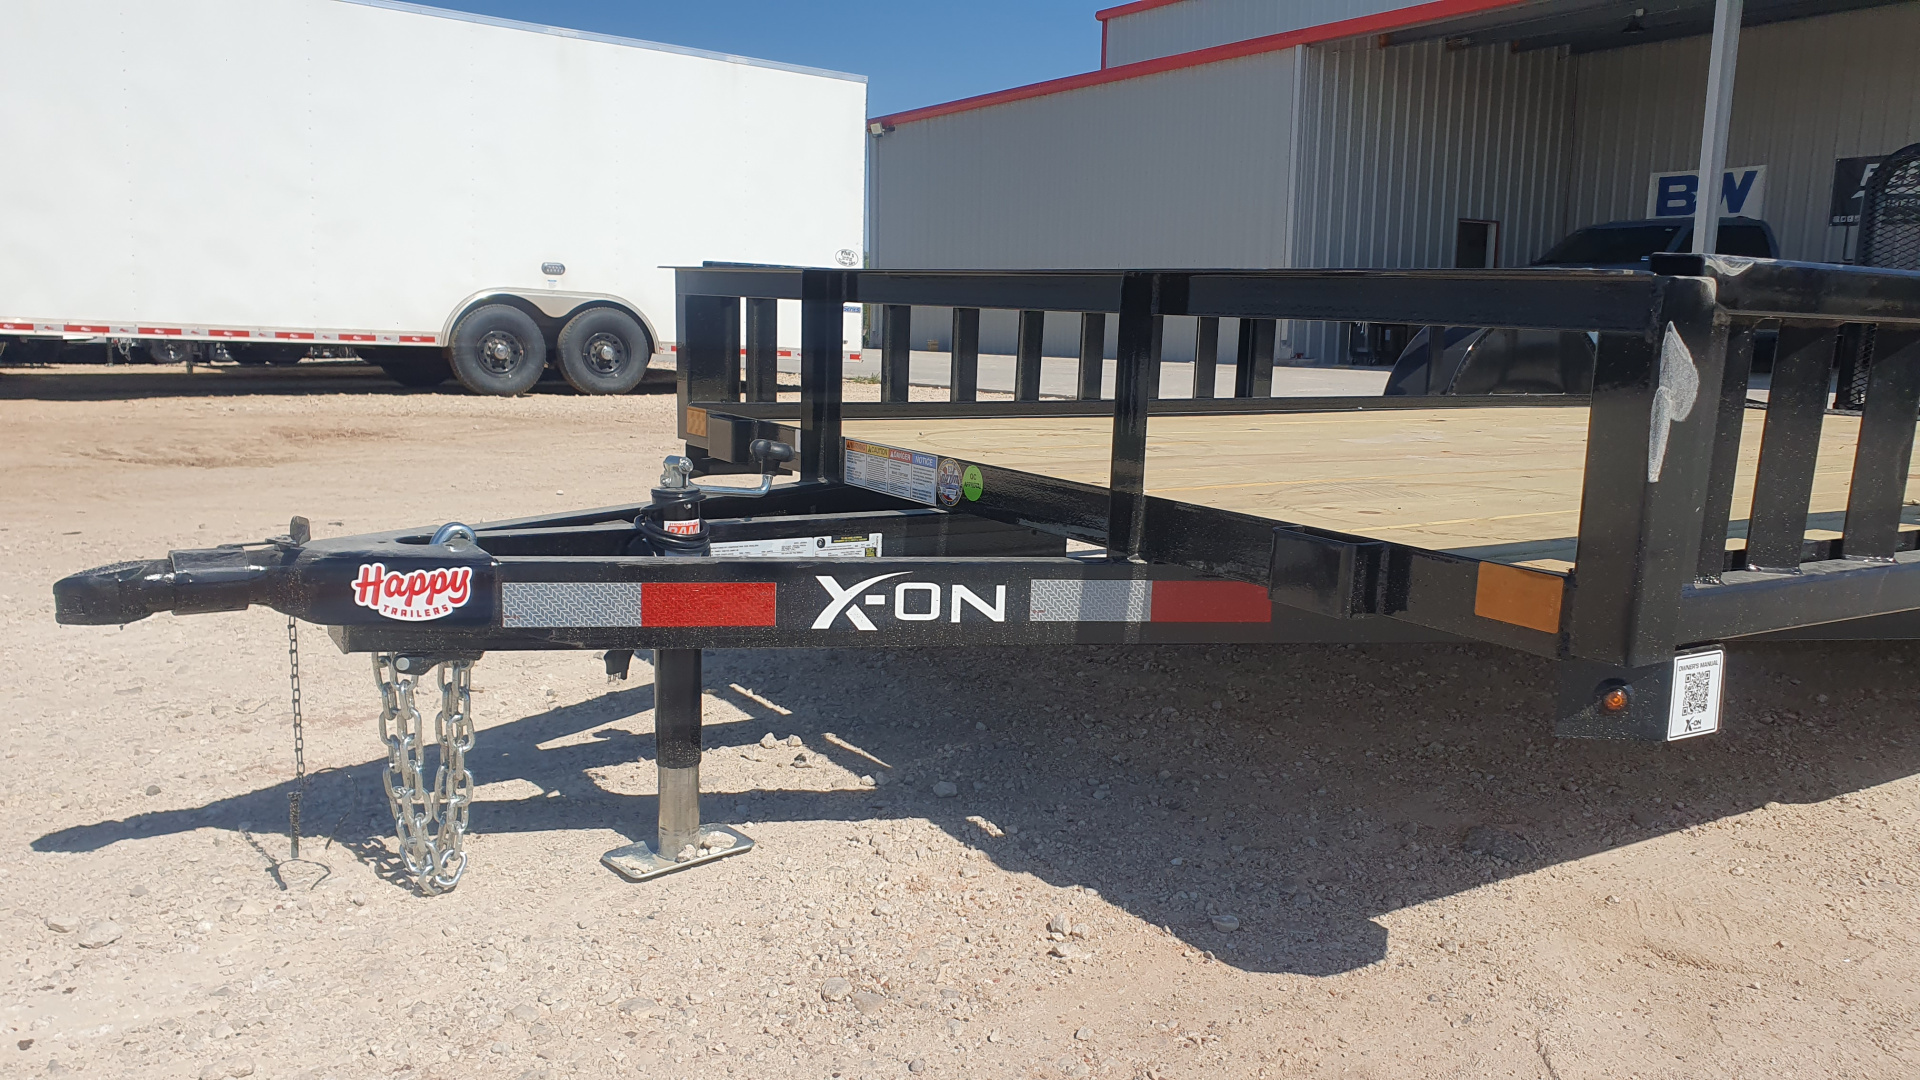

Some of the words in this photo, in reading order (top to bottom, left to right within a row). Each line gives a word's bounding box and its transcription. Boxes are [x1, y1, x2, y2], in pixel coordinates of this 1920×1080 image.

[893, 451, 911, 461] DANGER
[915, 456, 934, 466] NOTICE
[355, 565, 470, 607] Happy
[811, 570, 1006, 631] X-ON
[383, 604, 449, 618] TRAILERS
[1678, 662, 1699, 672] OWNER'S
[1700, 659, 1719, 669] MANUAL
[1684, 716, 1702, 732] X-ON
